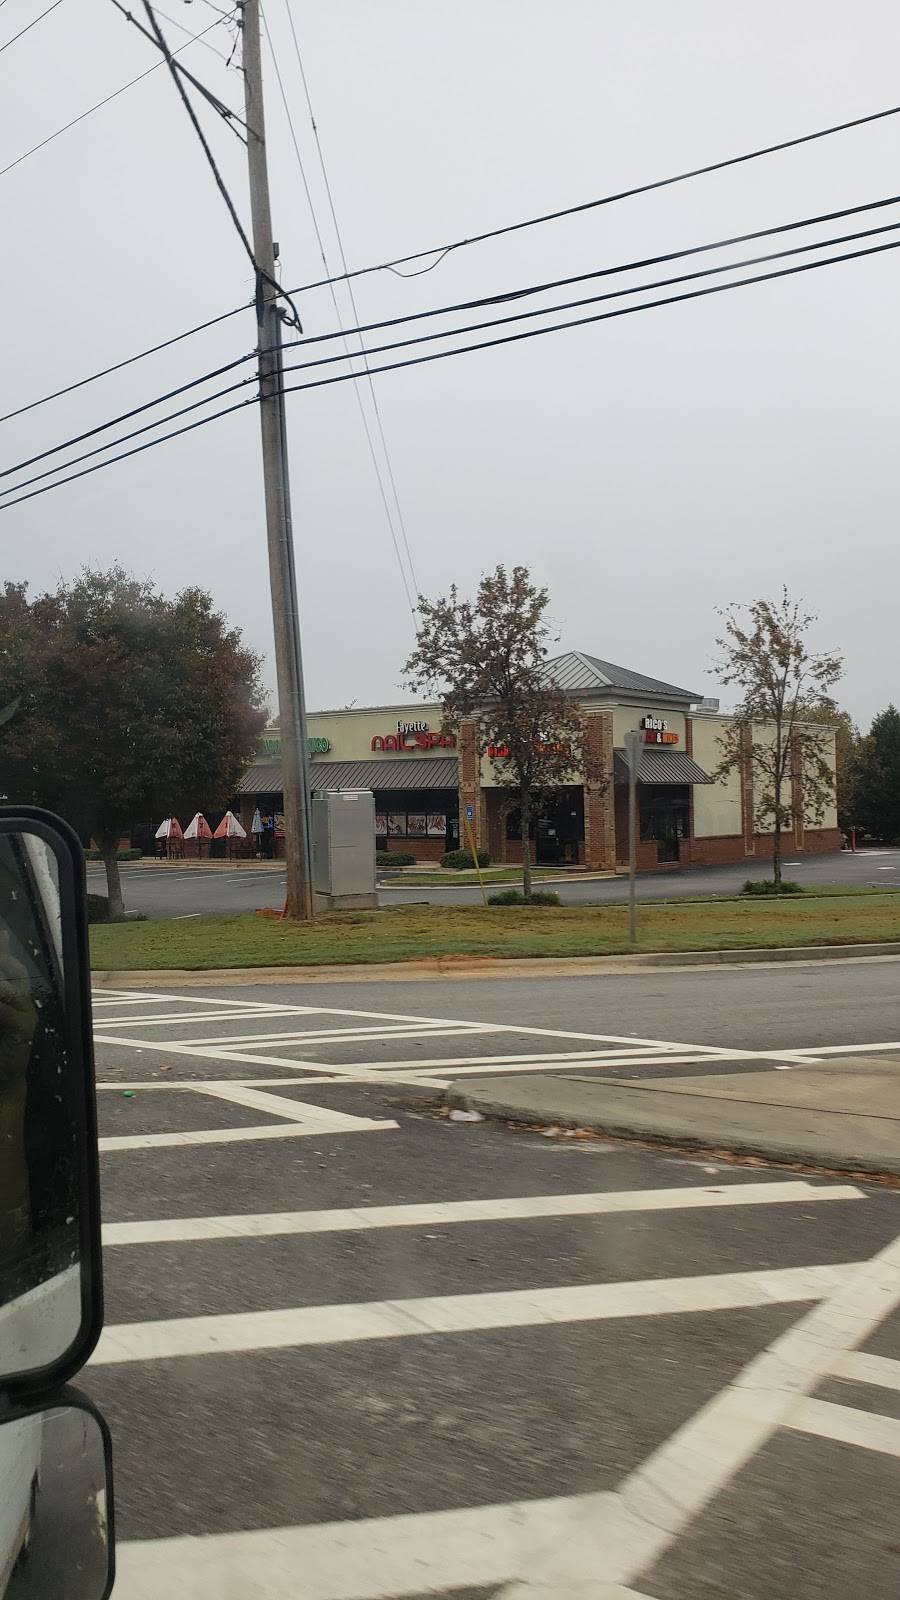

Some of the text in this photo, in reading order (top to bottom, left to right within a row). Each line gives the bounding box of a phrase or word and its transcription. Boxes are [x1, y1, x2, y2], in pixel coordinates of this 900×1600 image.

[645, 718, 668, 730] RICO'S
[415, 732, 457, 749] SPA
[656, 732, 662, 743] &
